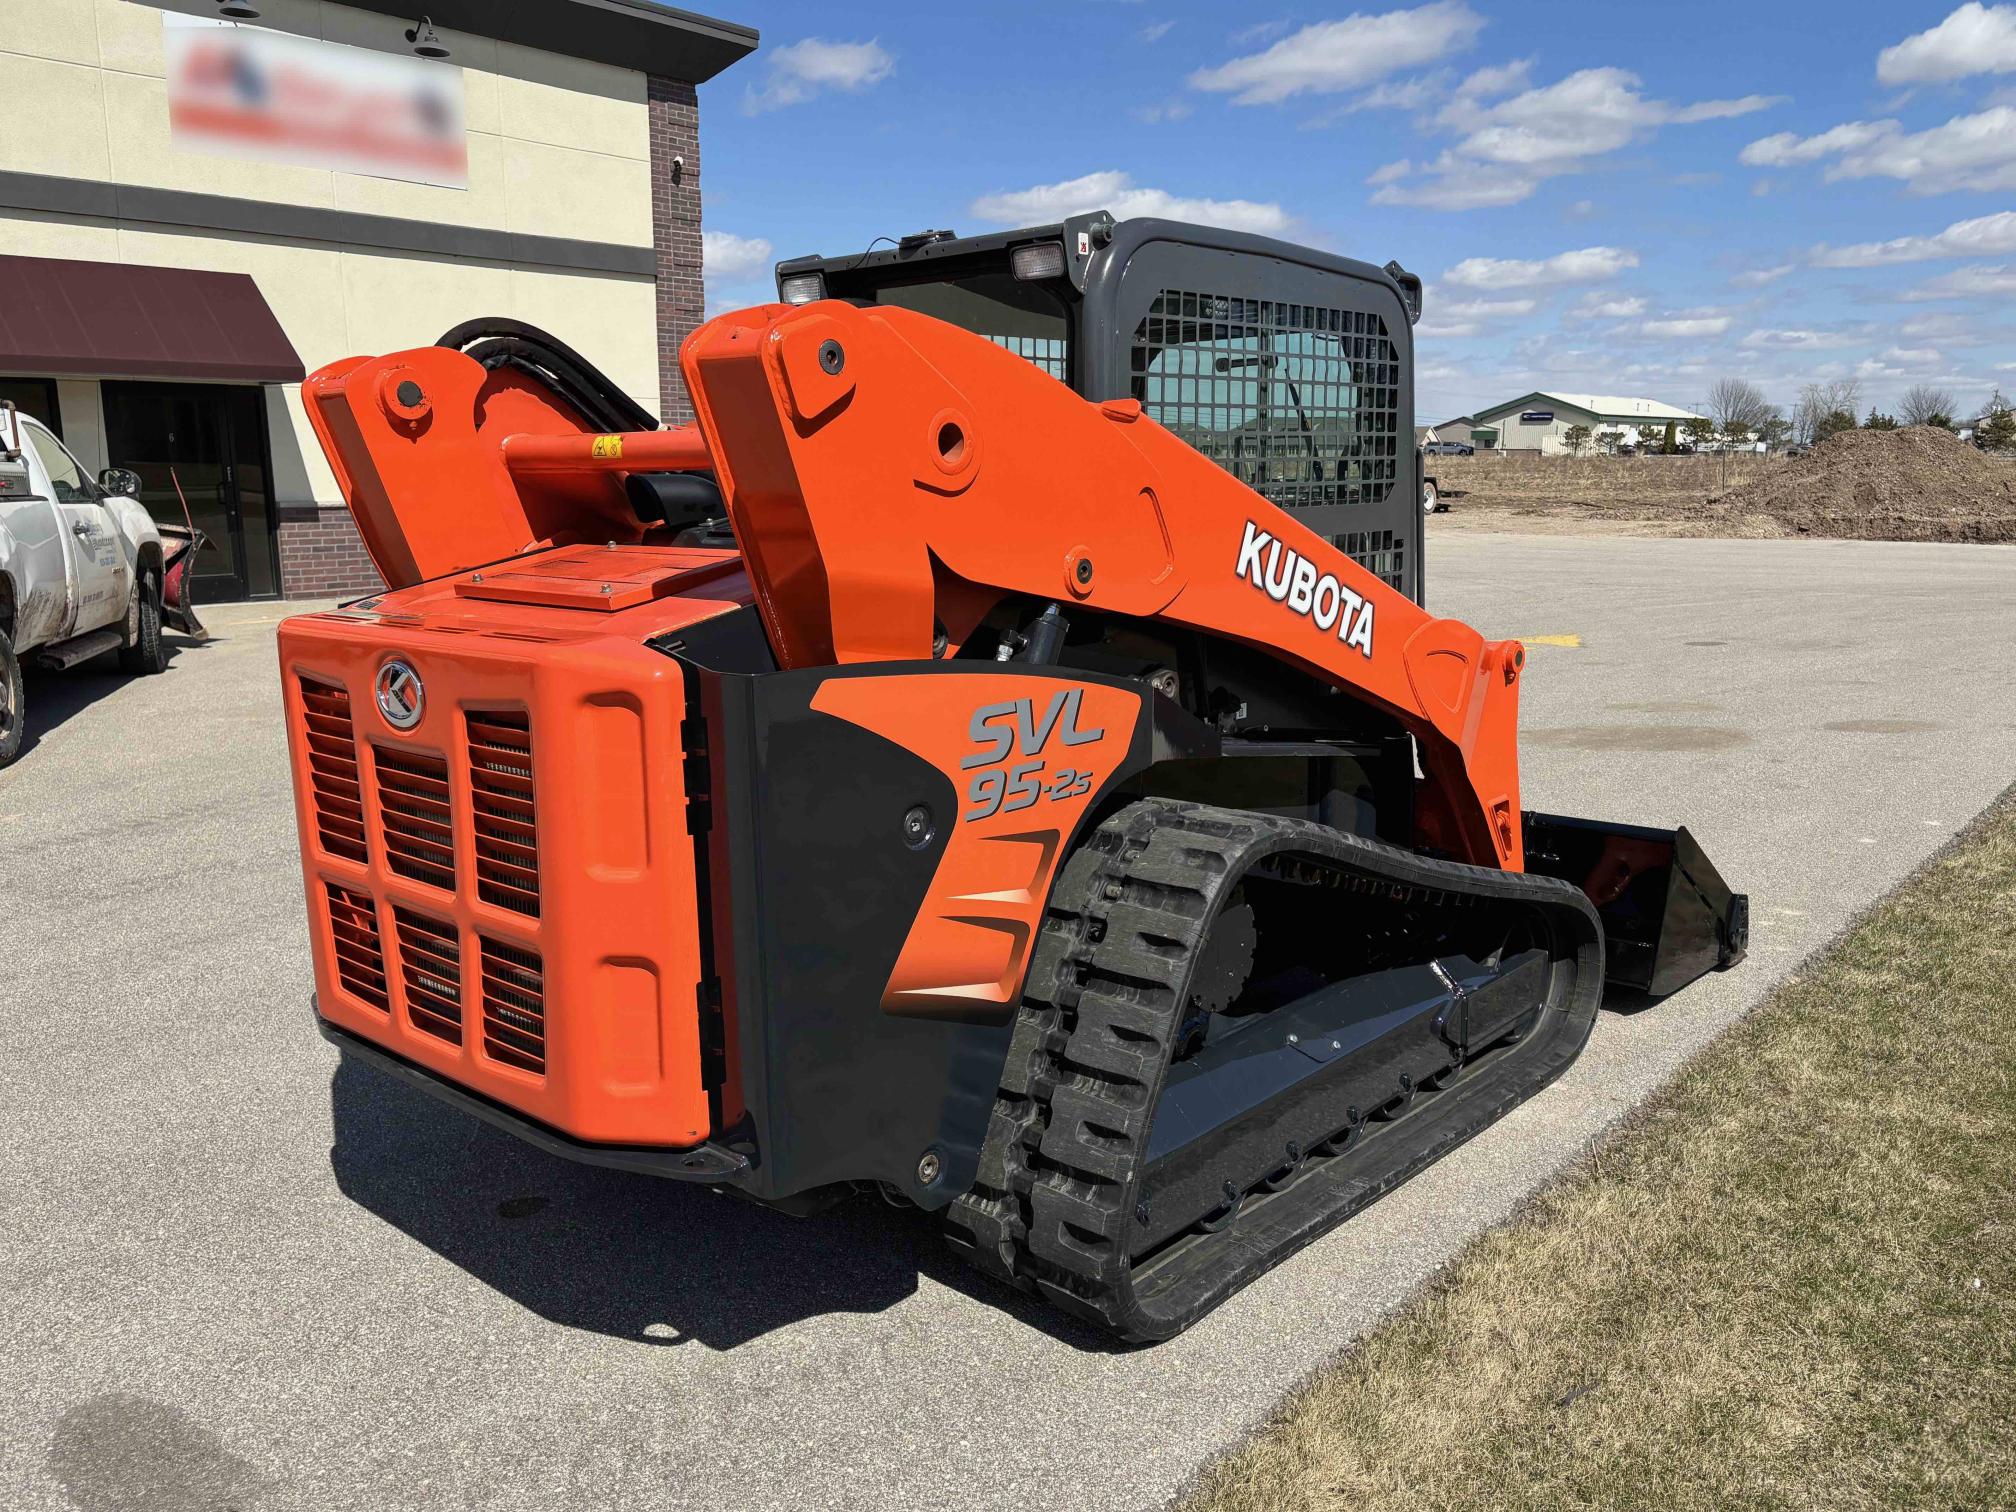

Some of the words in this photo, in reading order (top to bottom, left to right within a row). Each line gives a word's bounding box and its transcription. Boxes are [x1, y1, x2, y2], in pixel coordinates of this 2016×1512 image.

[168, 432, 175, 443] 6
[1236, 519, 1375, 659] KUBOTA
[960, 688, 1105, 770] SVL
